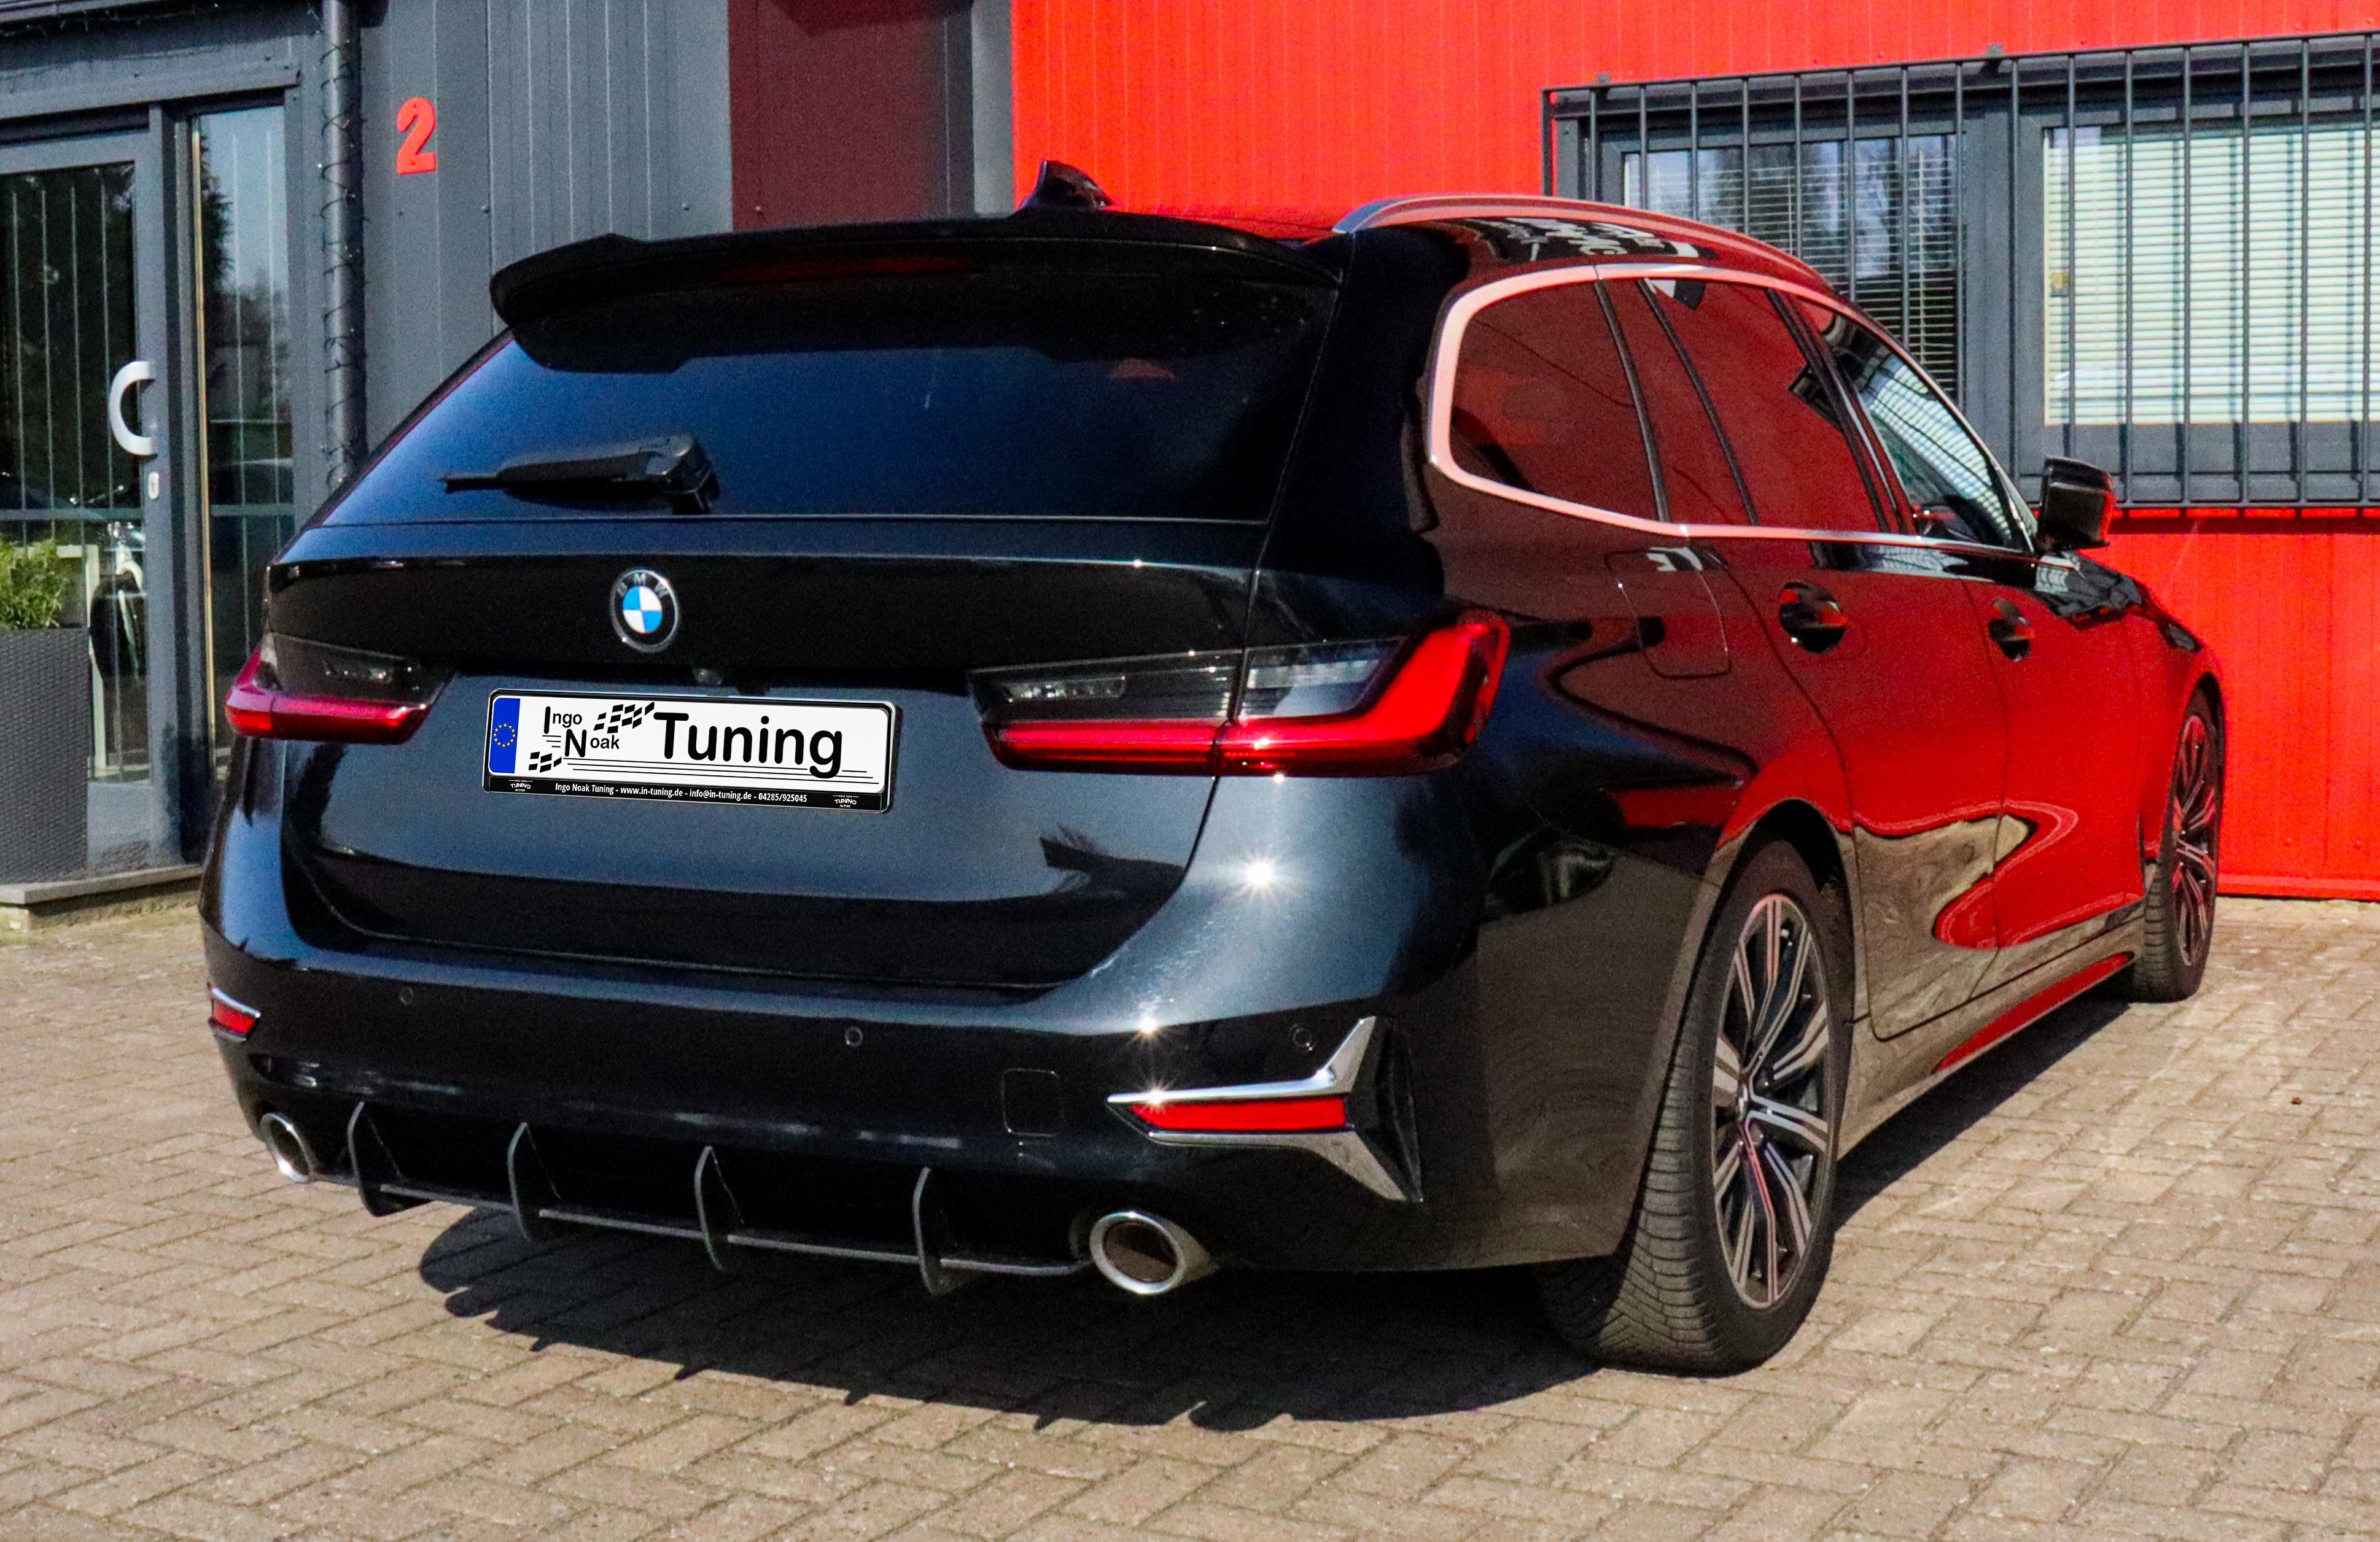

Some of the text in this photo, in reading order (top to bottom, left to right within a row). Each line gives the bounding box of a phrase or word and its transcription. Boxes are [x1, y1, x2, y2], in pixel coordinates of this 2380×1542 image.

[397, 96, 437, 176] 2
[544, 706, 583, 734] Ingo
[565, 729, 620, 757] Noak
[653, 712, 842, 778] Tuning
[555, 783, 570, 793] Ingo
[572, 783, 590, 792] Noak
[591, 785, 614, 796] Tuning
[620, 786, 683, 798] www.in-tuning.de
[690, 789, 752, 801] info@in-tuning.de
[758, 792, 807, 803] 04285/925045
